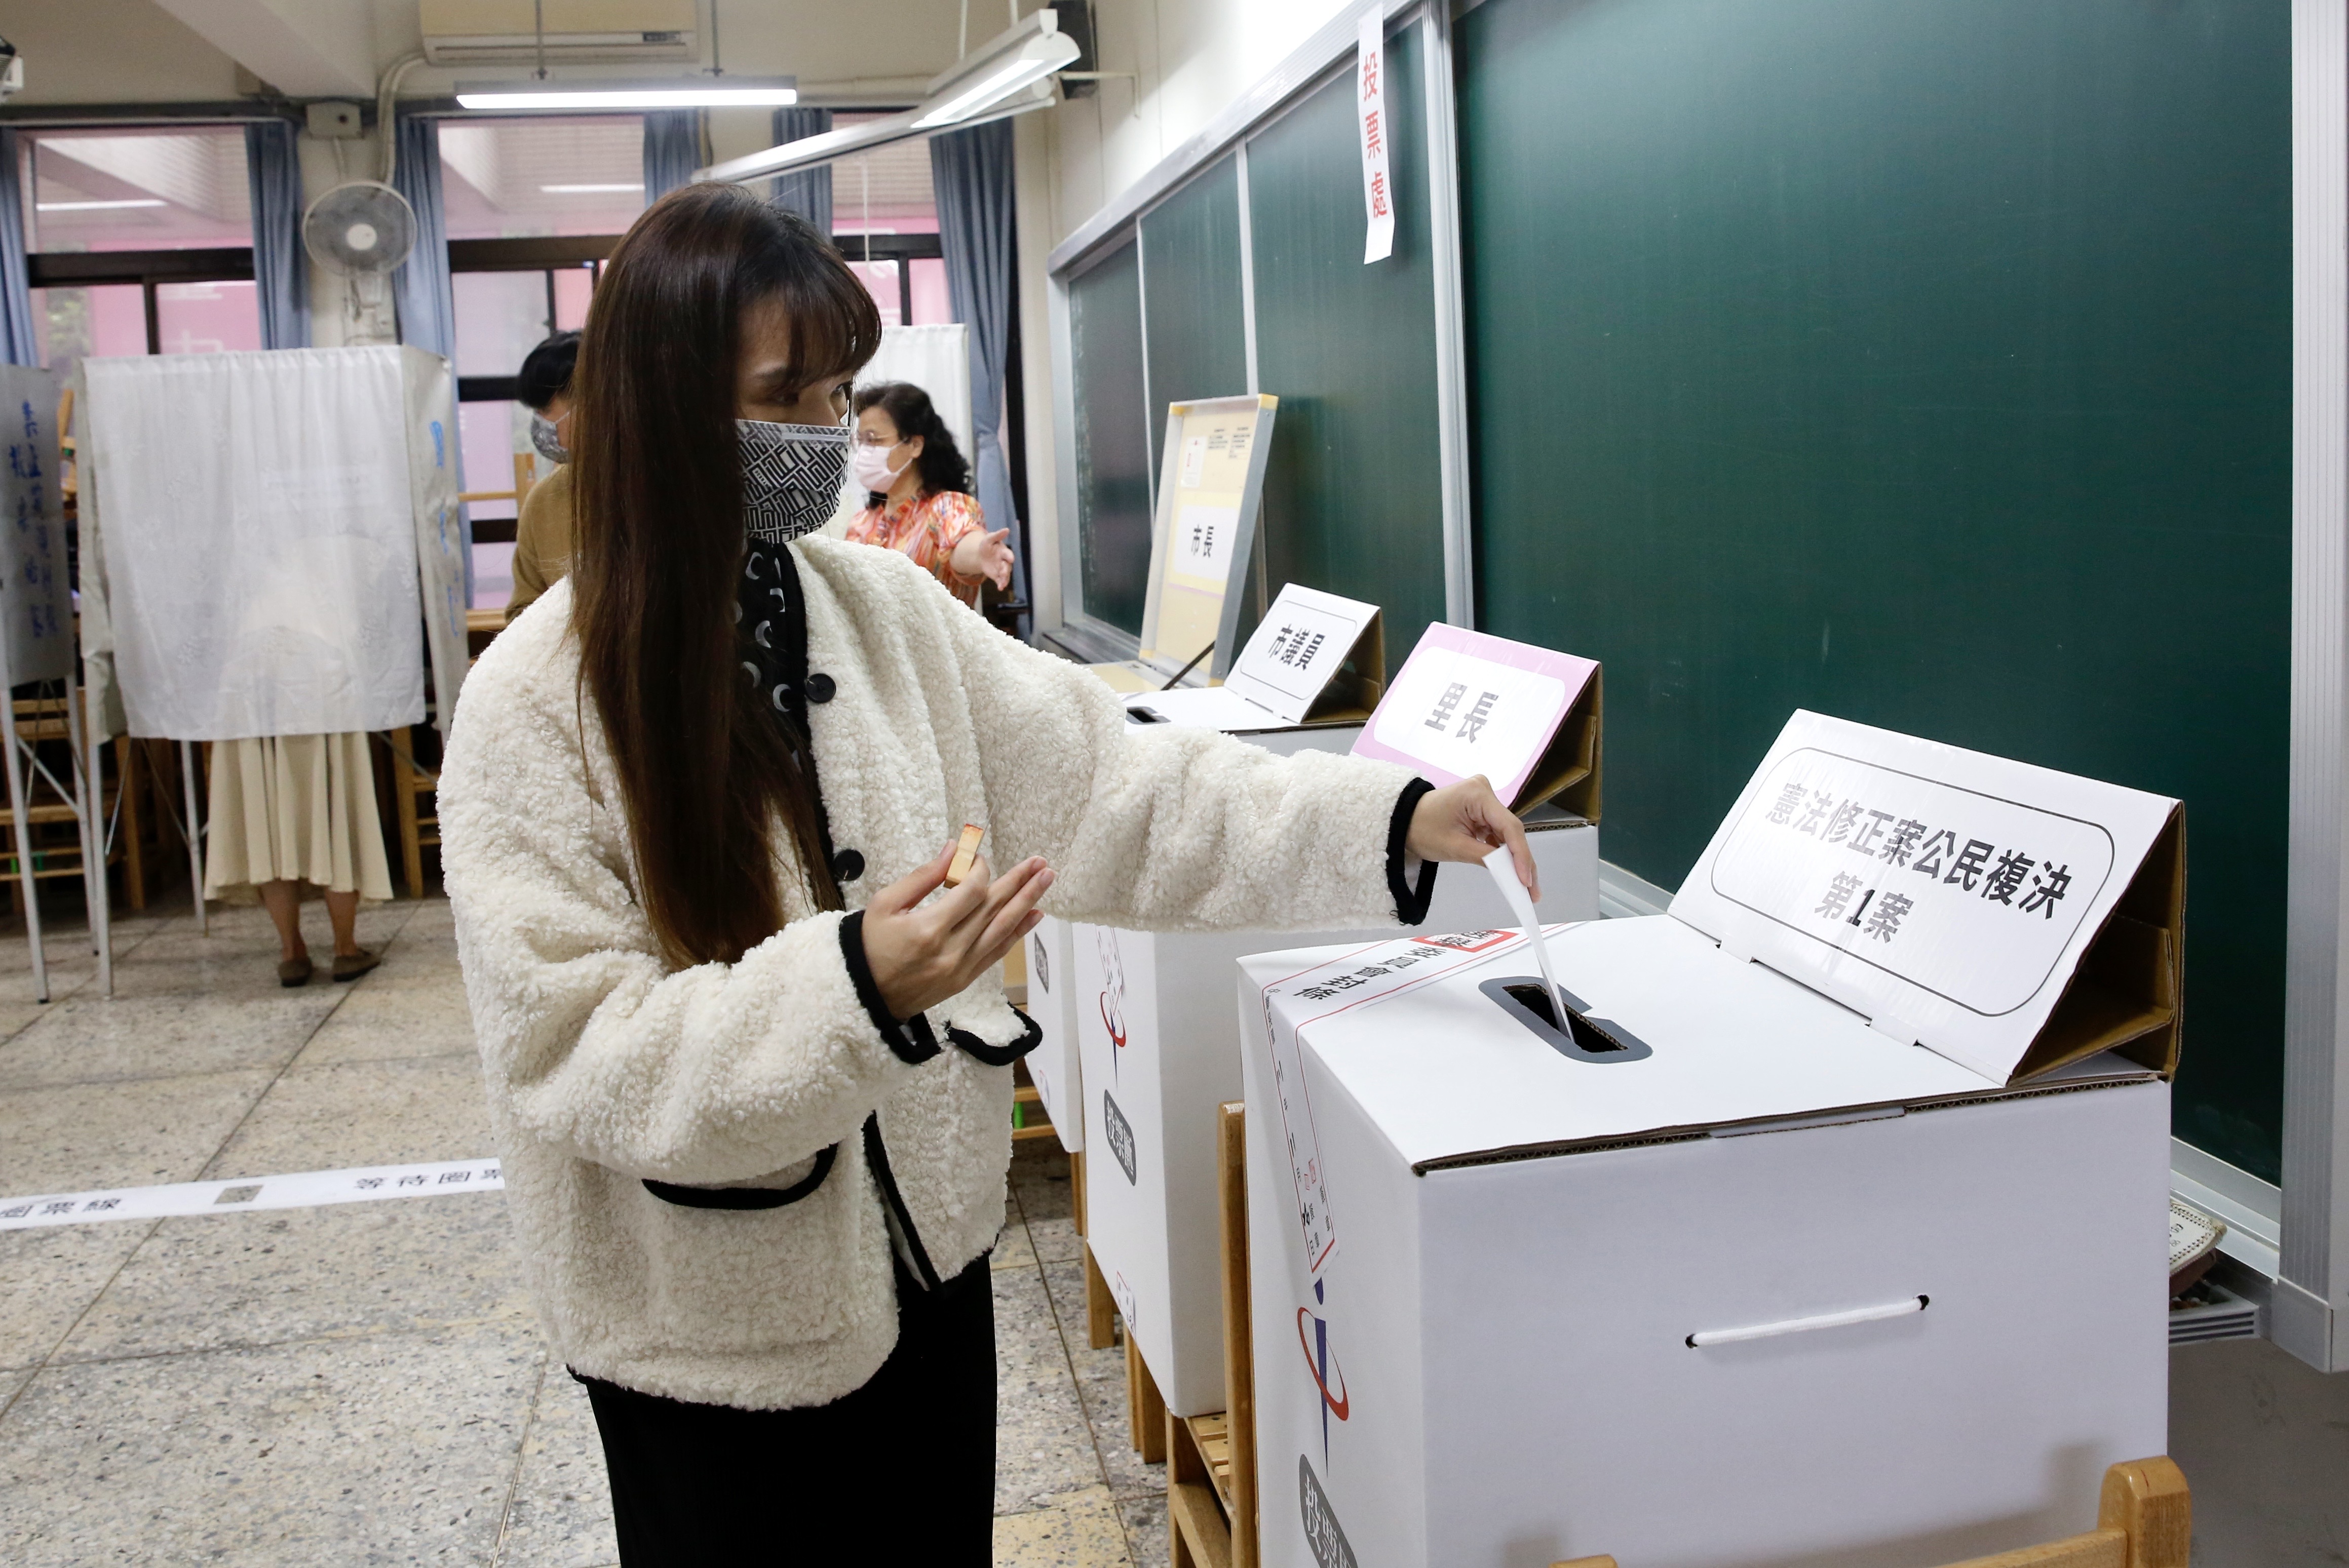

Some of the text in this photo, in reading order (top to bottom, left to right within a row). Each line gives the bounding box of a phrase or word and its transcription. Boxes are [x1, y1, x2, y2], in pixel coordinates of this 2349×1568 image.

[1363, 52, 1387, 219] 投票處
[1191, 524, 1214, 558] 市長
[1267, 623, 1326, 671] 市議員
[1424, 682, 1499, 743] 里長
[1764, 783, 2073, 921] 憲法修正案公民複決
[1814, 870, 1914, 944] 第1案
